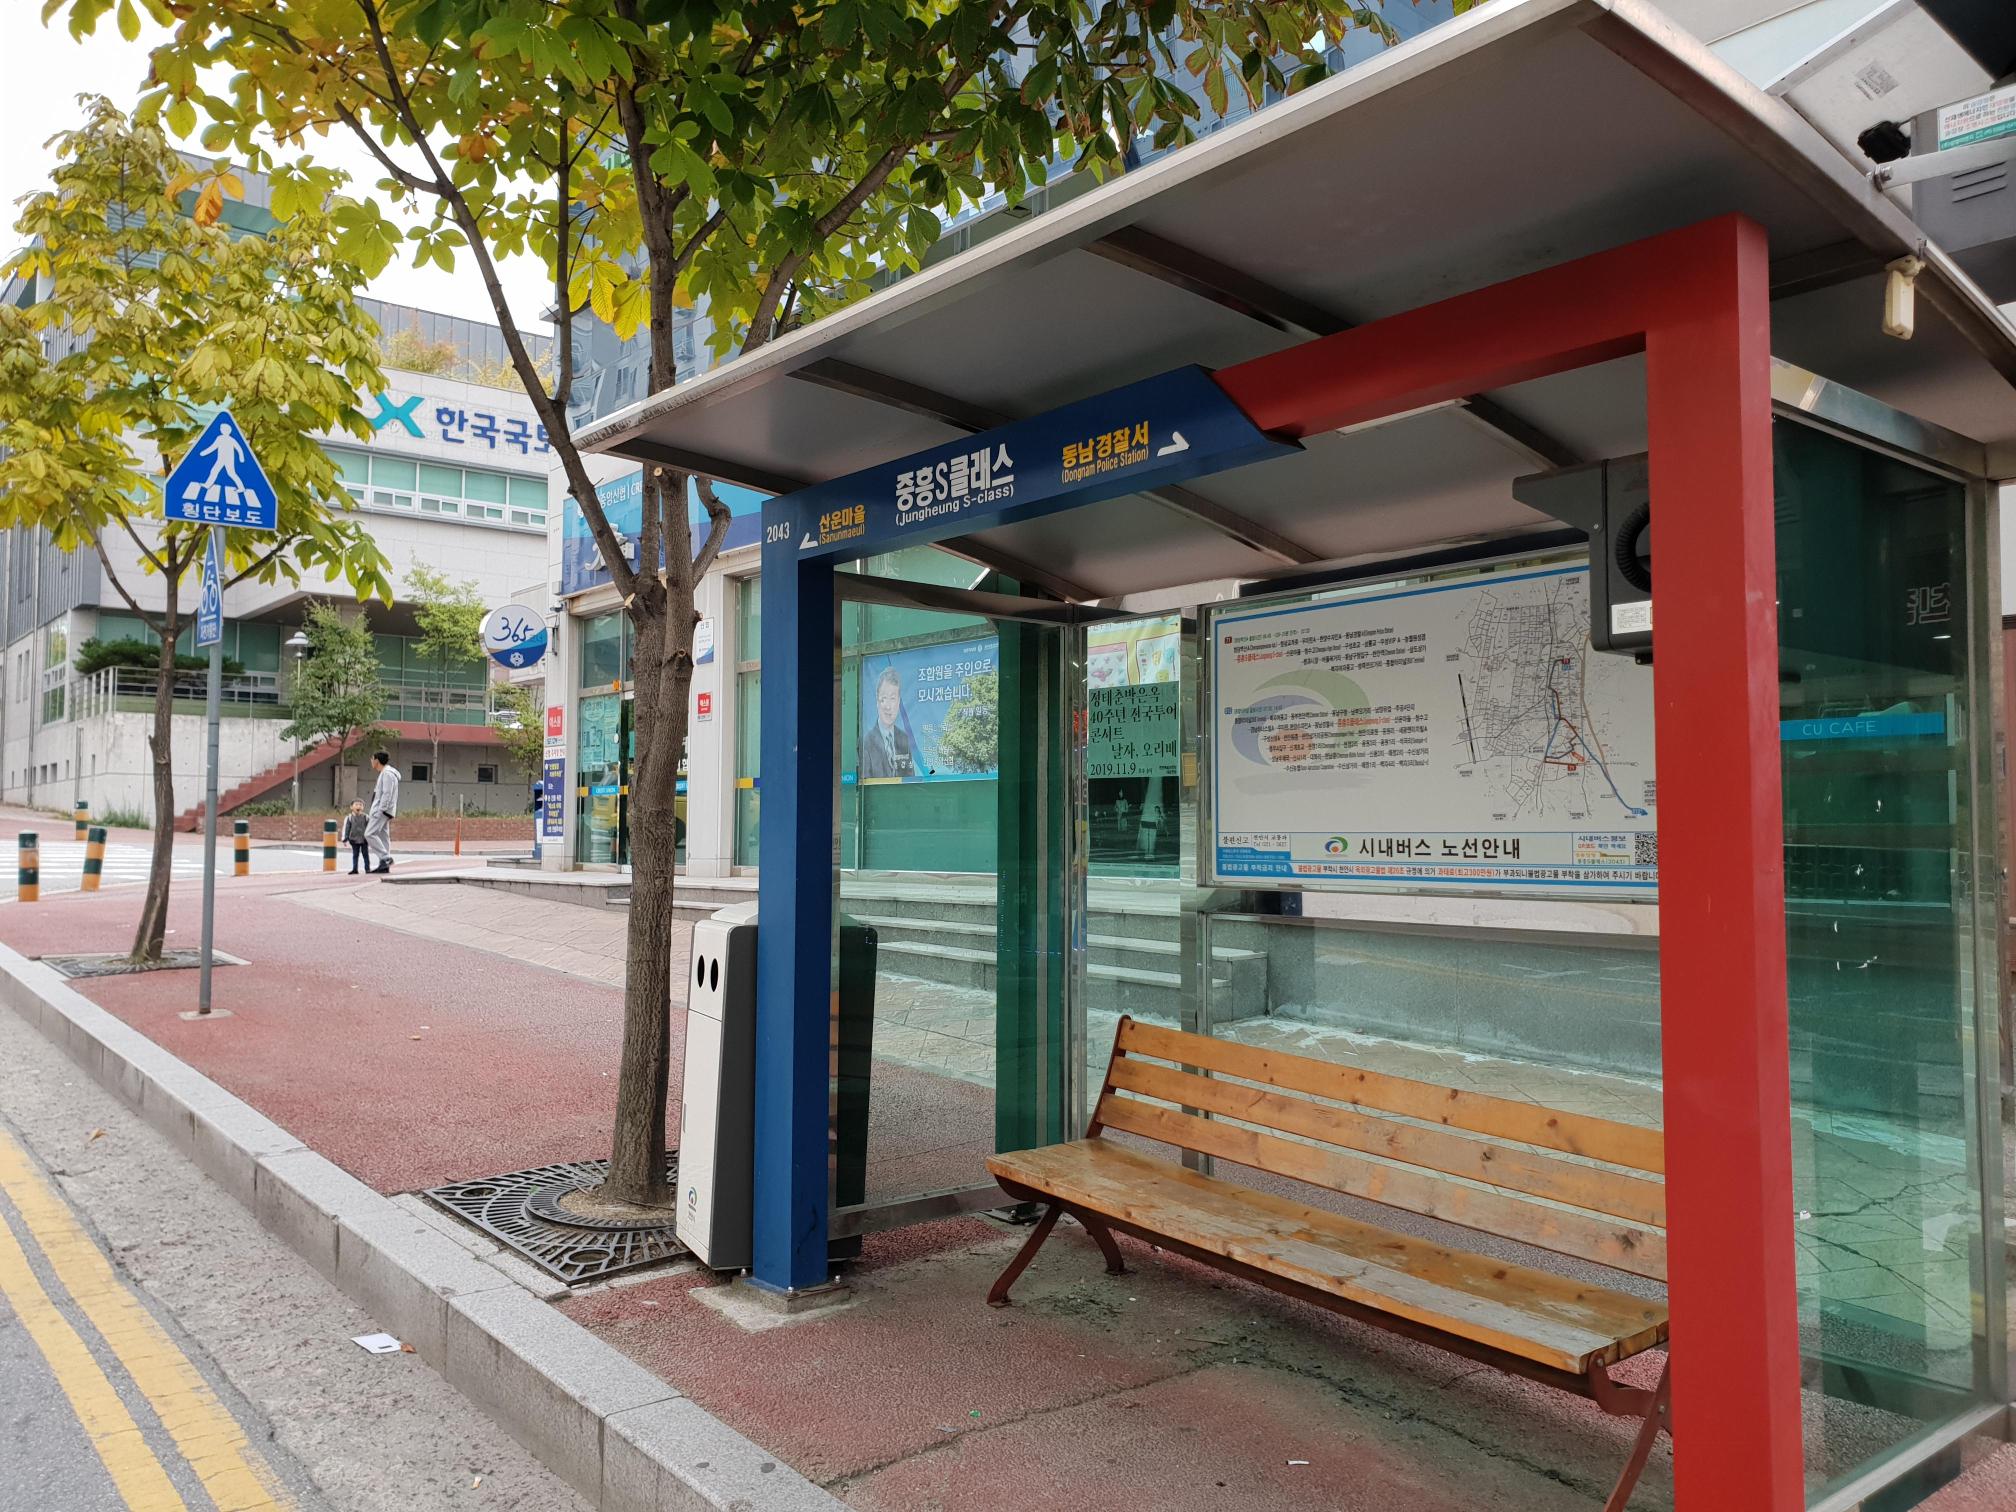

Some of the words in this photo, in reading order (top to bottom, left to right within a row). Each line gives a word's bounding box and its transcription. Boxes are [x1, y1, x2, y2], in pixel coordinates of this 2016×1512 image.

[1062, 421, 1149, 467] 동남경찰서
[1061, 463, 1096, 484] (Dongnam
[1096, 456, 1118, 476] Police
[1120, 447, 1149, 471] Station)
[895, 443, 1014, 512] 중흥S클래스
[182, 503, 263, 525] 횡단보도
[896, 497, 960, 526] (Jungheung
[963, 484, 1014, 508] S-class)
[819, 504, 866, 533] 산운마을
[767, 522, 790, 543] 2043
[819, 524, 865, 546] (Sanunmaeul)
[492, 617, 535, 643] 365
[918, 664, 953, 682] 조합원을
[955, 659, 992, 677] 주인으로
[918, 684, 973, 702] 모시겠습니다.
[1091, 687, 1160, 707] 정태춘박은옥
[1090, 707, 1126, 725] 40주년
[1131, 703, 1177, 723] 전국투어
[1090, 726, 1125, 743] 콘서트
[1802, 723, 1823, 736] CU
[1830, 721, 1877, 735] CAFE
[1112, 742, 1139, 760] 날자,
[1142, 740, 1177, 758] 오리배
[1090, 763, 1136, 776] 2019.11.9
[1360, 837, 1431, 858] 시내버스
[1441, 838, 1520, 860] 노선안내
[1583, 870, 1610, 880] 삼가하여
[1612, 871, 1632, 880] 주시기
